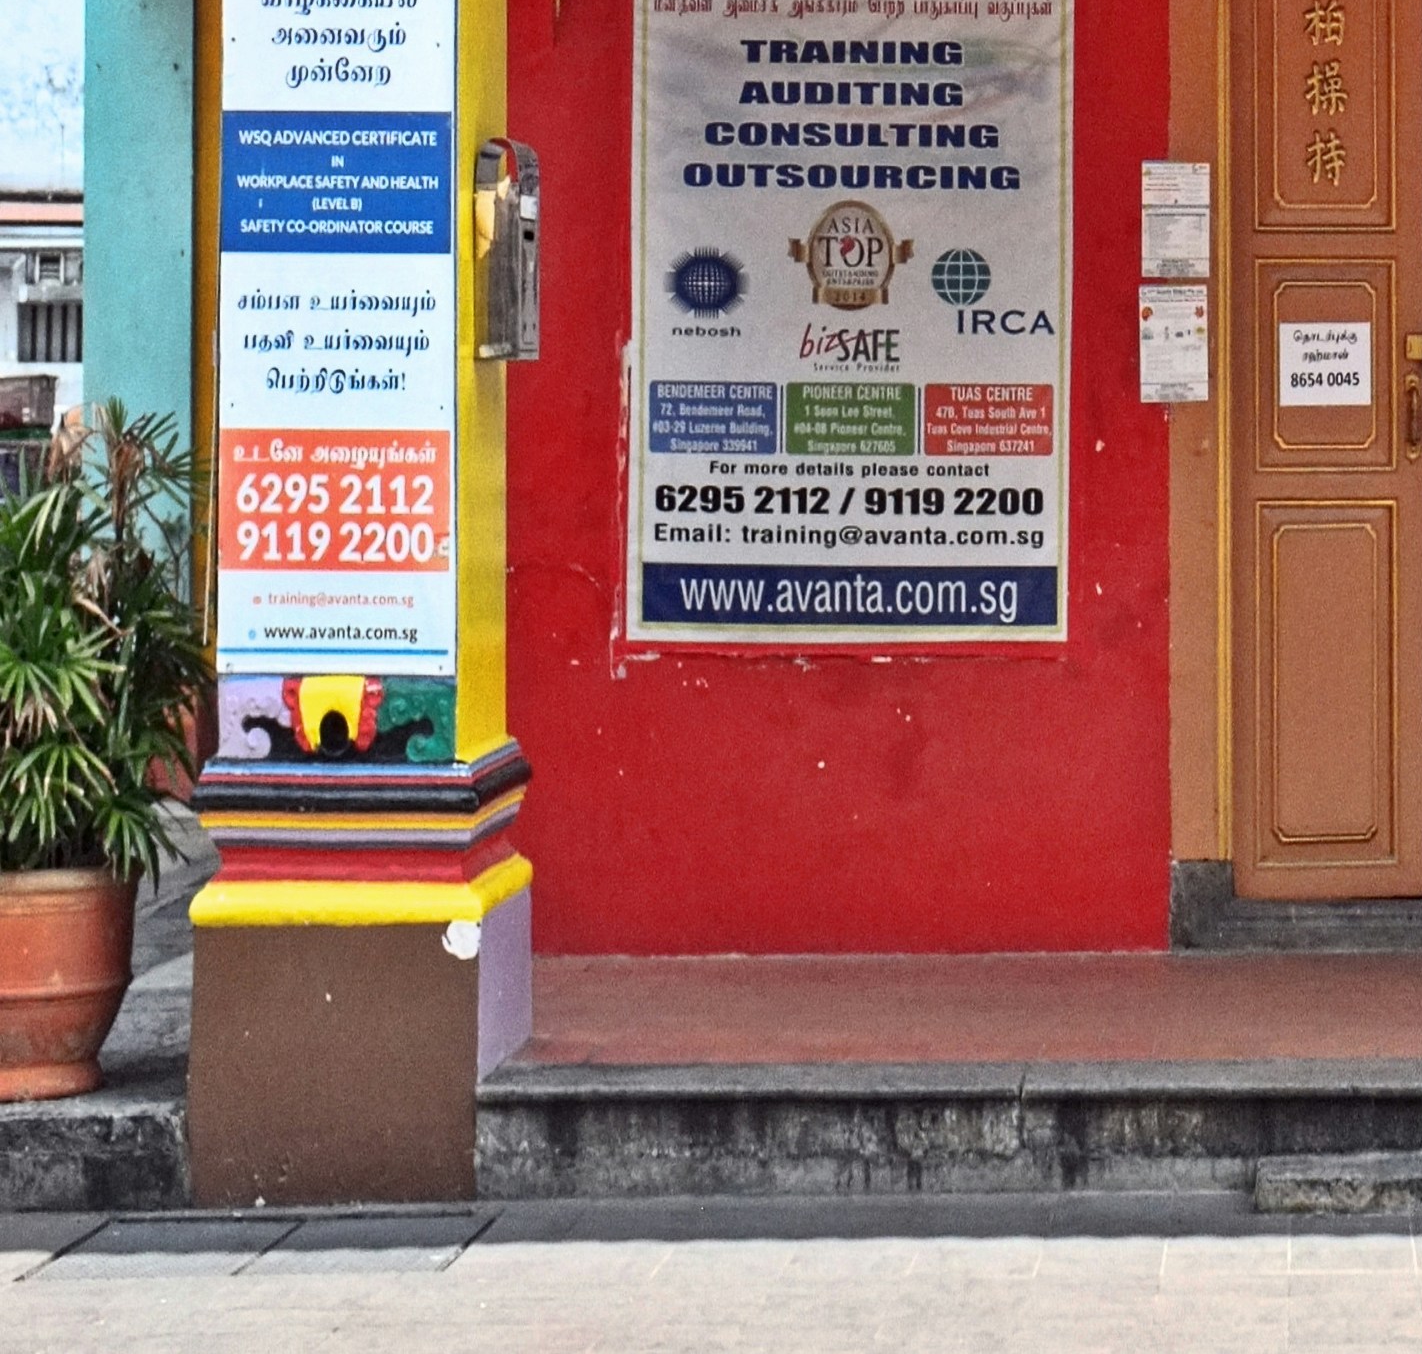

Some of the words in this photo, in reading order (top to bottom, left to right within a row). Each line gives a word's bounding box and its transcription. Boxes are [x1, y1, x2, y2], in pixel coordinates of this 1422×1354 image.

[740, 40, 963, 65] TRAINING
[738, 81, 963, 106] AUDITING
[239, 130, 272, 146] WSQ
[275, 131, 350, 145] ADVANCED
[353, 131, 438, 146] CERTIFICATE
[704, 122, 999, 148] CONSULTING
[331, 155, 344, 167] IN
[237, 175, 314, 188] WORKPLACE
[315, 175, 359, 189] SAFETY
[361, 175, 388, 189] AND
[391, 176, 438, 189] HEALTH
[683, 163, 1020, 189] OUTSOURCING
[312, 197, 350, 210] (LEVEL
[240, 219, 284, 232] SAFETY
[287, 220, 382, 233] CO-ORDINATOR
[385, 221, 434, 234] COURSE
[828, 216, 874, 234] ASIA
[819, 236, 883, 268] TOP
[672, 326, 741, 337] nebosh
[958, 310, 1054, 334] IRCA
[1291, 372, 1323, 388] 8654
[1327, 372, 1360, 386] 0045
[657, 384, 725, 398] BENDEMEER
[729, 385, 773, 399] CENTRE
[803, 385, 852, 399] PIONEER
[857, 385, 901, 400] CENTRE
[950, 387, 981, 401] TUAS
[986, 387, 1033, 401] CENTRE
[710, 460, 736, 474] For
[744, 464, 788, 475] more
[796, 463, 854, 476] details
[862, 463, 918, 479] please
[927, 464, 989, 476] contact
[236, 473, 330, 514] 6295
[339, 474, 434, 514] 2112
[656, 485, 744, 513] 6295
[755, 487, 829, 514] 2112
[866, 488, 944, 515] 9119
[955, 488, 1043, 515] 2200
[236, 520, 331, 561] 9119
[338, 522, 434, 562] 2200
[655, 523, 730, 542] Email:
[742, 525, 1044, 549] training@avanta.com.sg
[268, 592, 414, 608] training@avanta.com.sg
[681, 574, 1017, 623] www.avanta.com.sg
[264, 625, 417, 644] www.avanta.com.sg
